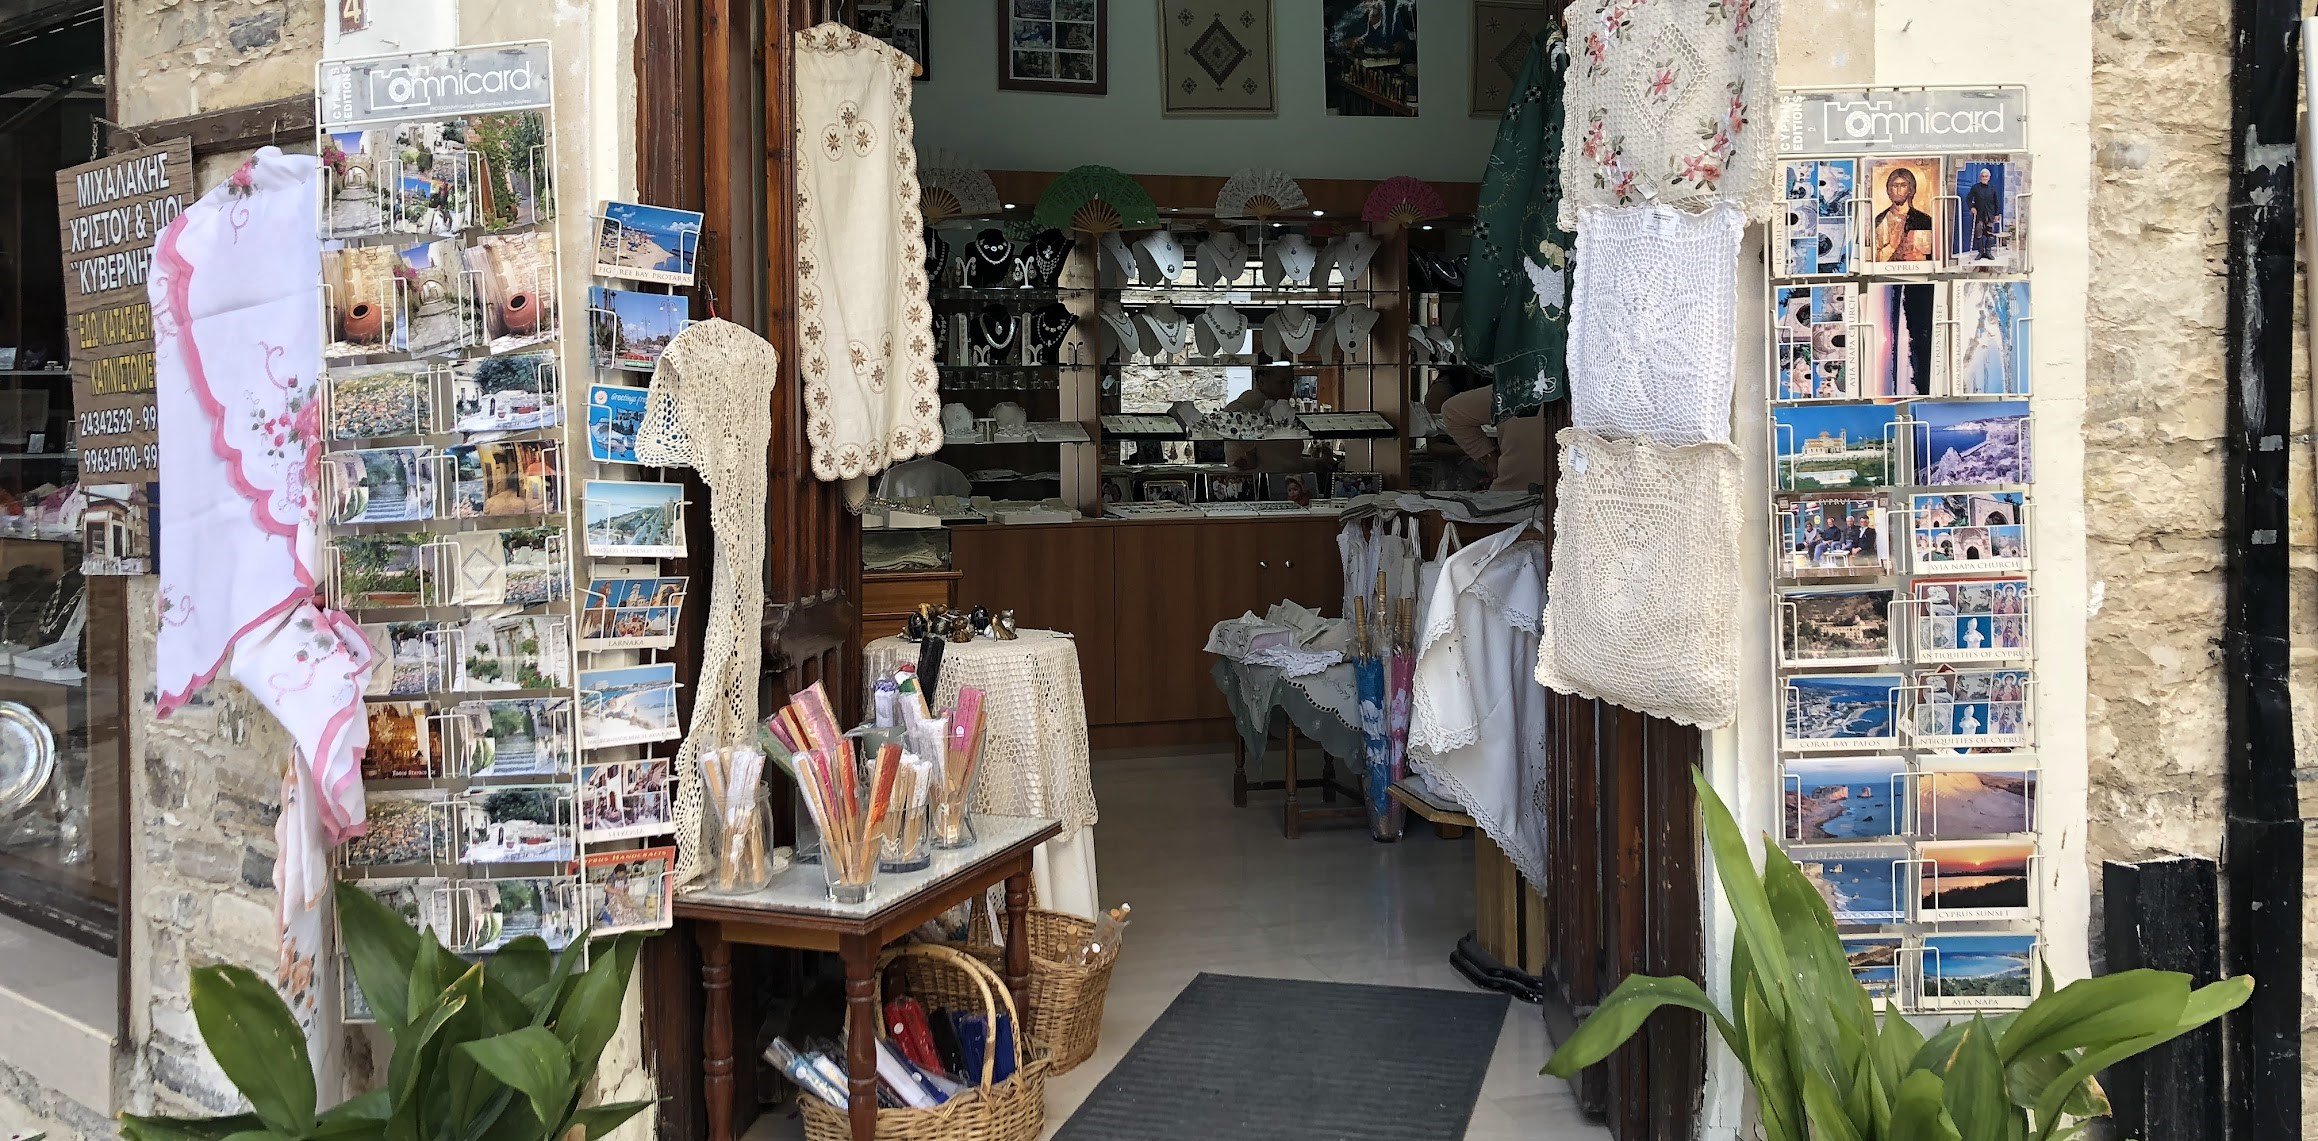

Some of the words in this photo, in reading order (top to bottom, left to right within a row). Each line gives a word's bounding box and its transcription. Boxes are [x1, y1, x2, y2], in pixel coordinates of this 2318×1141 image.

[343, 0, 361, 23] 4
[342, 65, 353, 119] EDITIONS
[388, 60, 531, 103] omnicard
[1792, 95, 1804, 151] EDITIONS
[1845, 102, 2004, 138] omnicard
[76, 152, 170, 208] ΜΙΧΑΛΑΚΗΣ
[69, 207, 131, 253] ΧΡΙΣΤΟΥ
[135, 203, 148, 239] &
[635, 269, 649, 278] BAY
[652, 272, 692, 283] PROTARAS
[1884, 264, 1920, 272] CYPRUS
[80, 407, 133, 437] 24342529
[142, 405, 157, 431] 99
[143, 443, 158, 470] 99
[1951, 562, 1976, 570] NAPA
[1977, 560, 2020, 569] CHURCH
[608, 639, 645, 647] LARNAKA
[1799, 740, 1830, 749] CORAL
[1833, 739, 1849, 748] BAY
[1917, 736, 1973, 746] NTIQUITIES
[1938, 910, 1973, 918] CYPRUS
[1976, 909, 2010, 917] SUNSET
